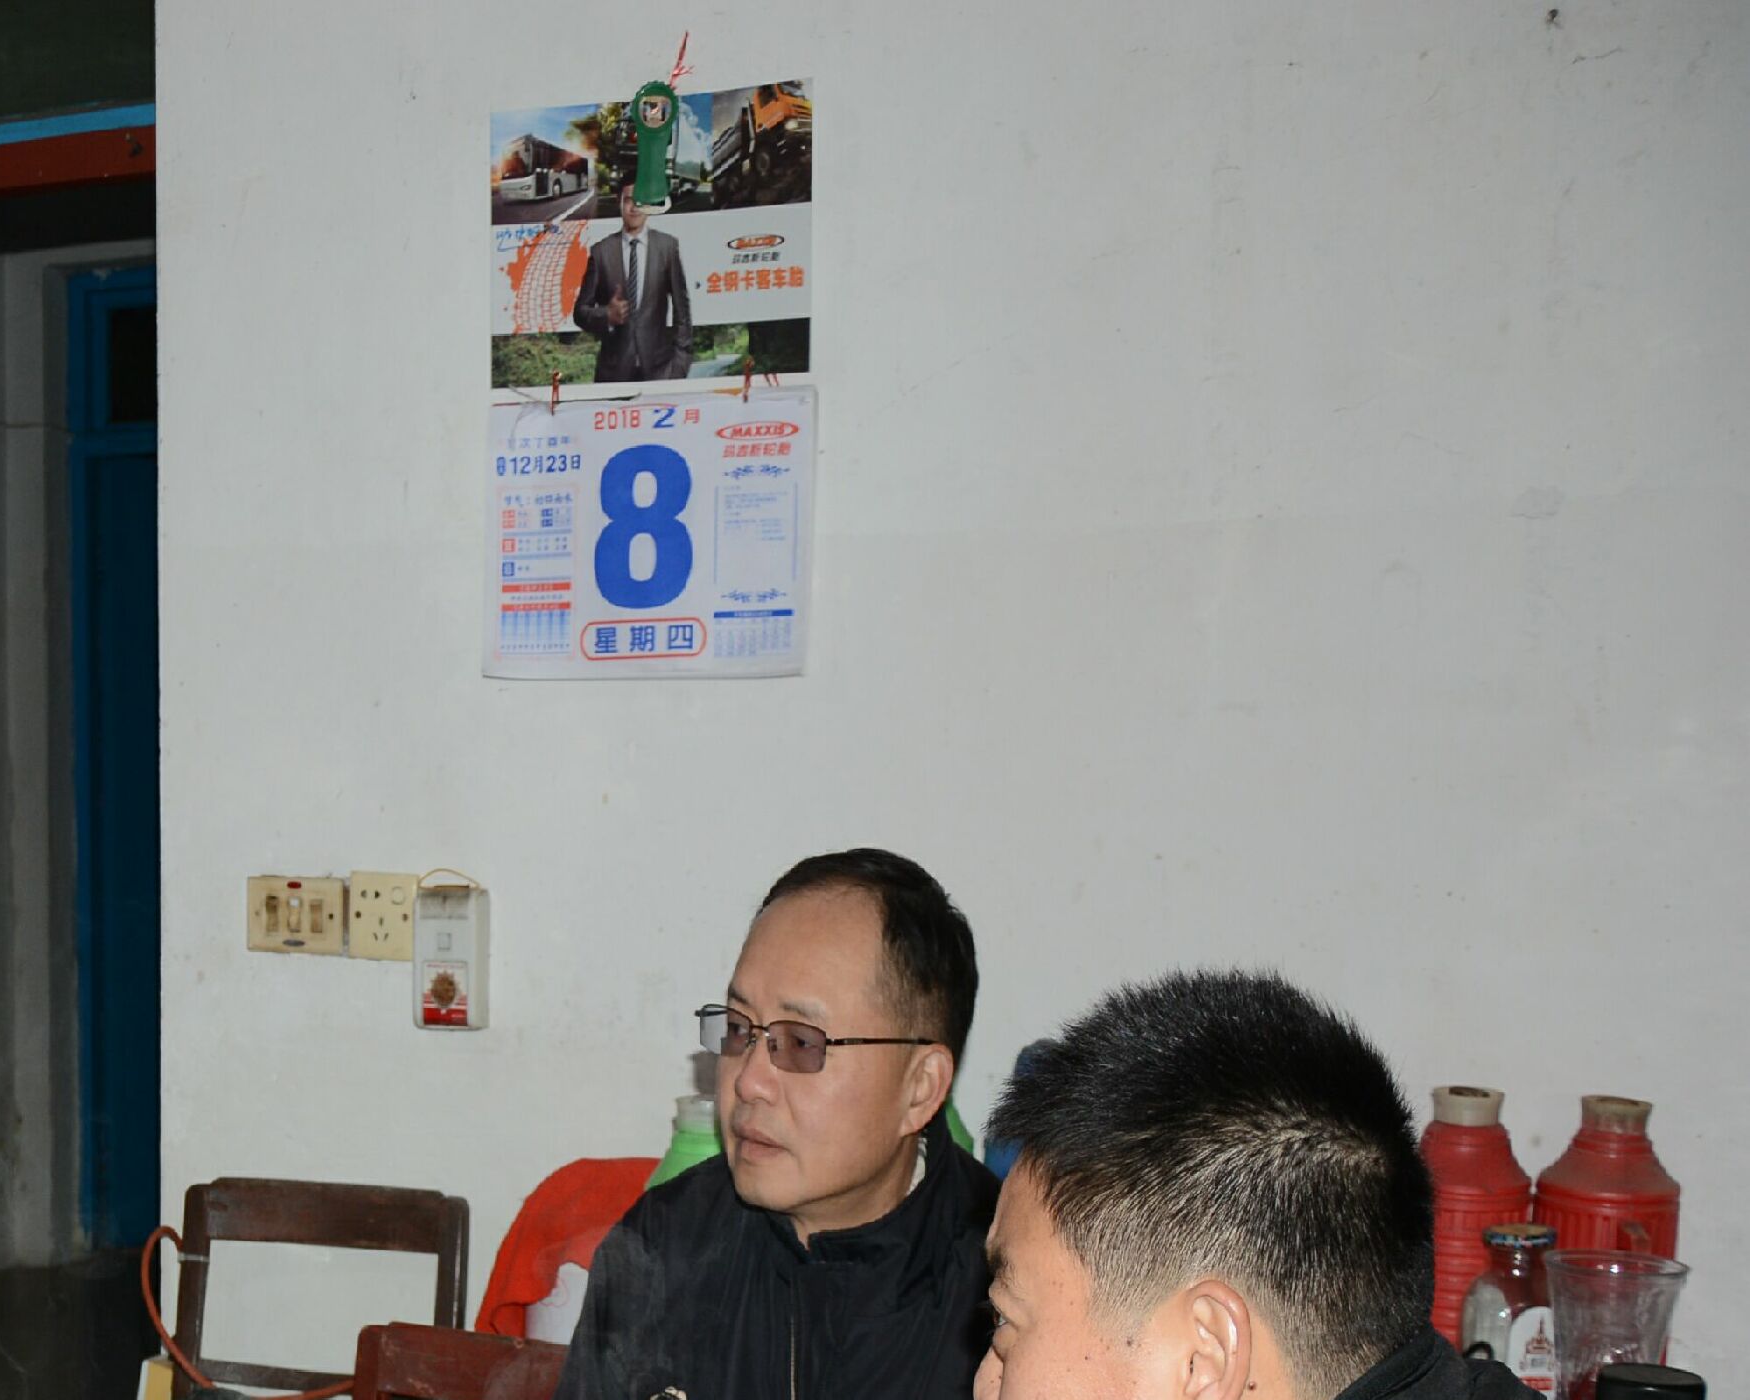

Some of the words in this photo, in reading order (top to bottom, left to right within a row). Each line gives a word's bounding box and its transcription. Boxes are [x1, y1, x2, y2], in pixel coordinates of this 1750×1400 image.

[594, 409, 641, 431] 2018
[731, 422, 786, 438] MAXXIS
[594, 444, 694, 610] 8
[594, 624, 694, 654] 星期四
